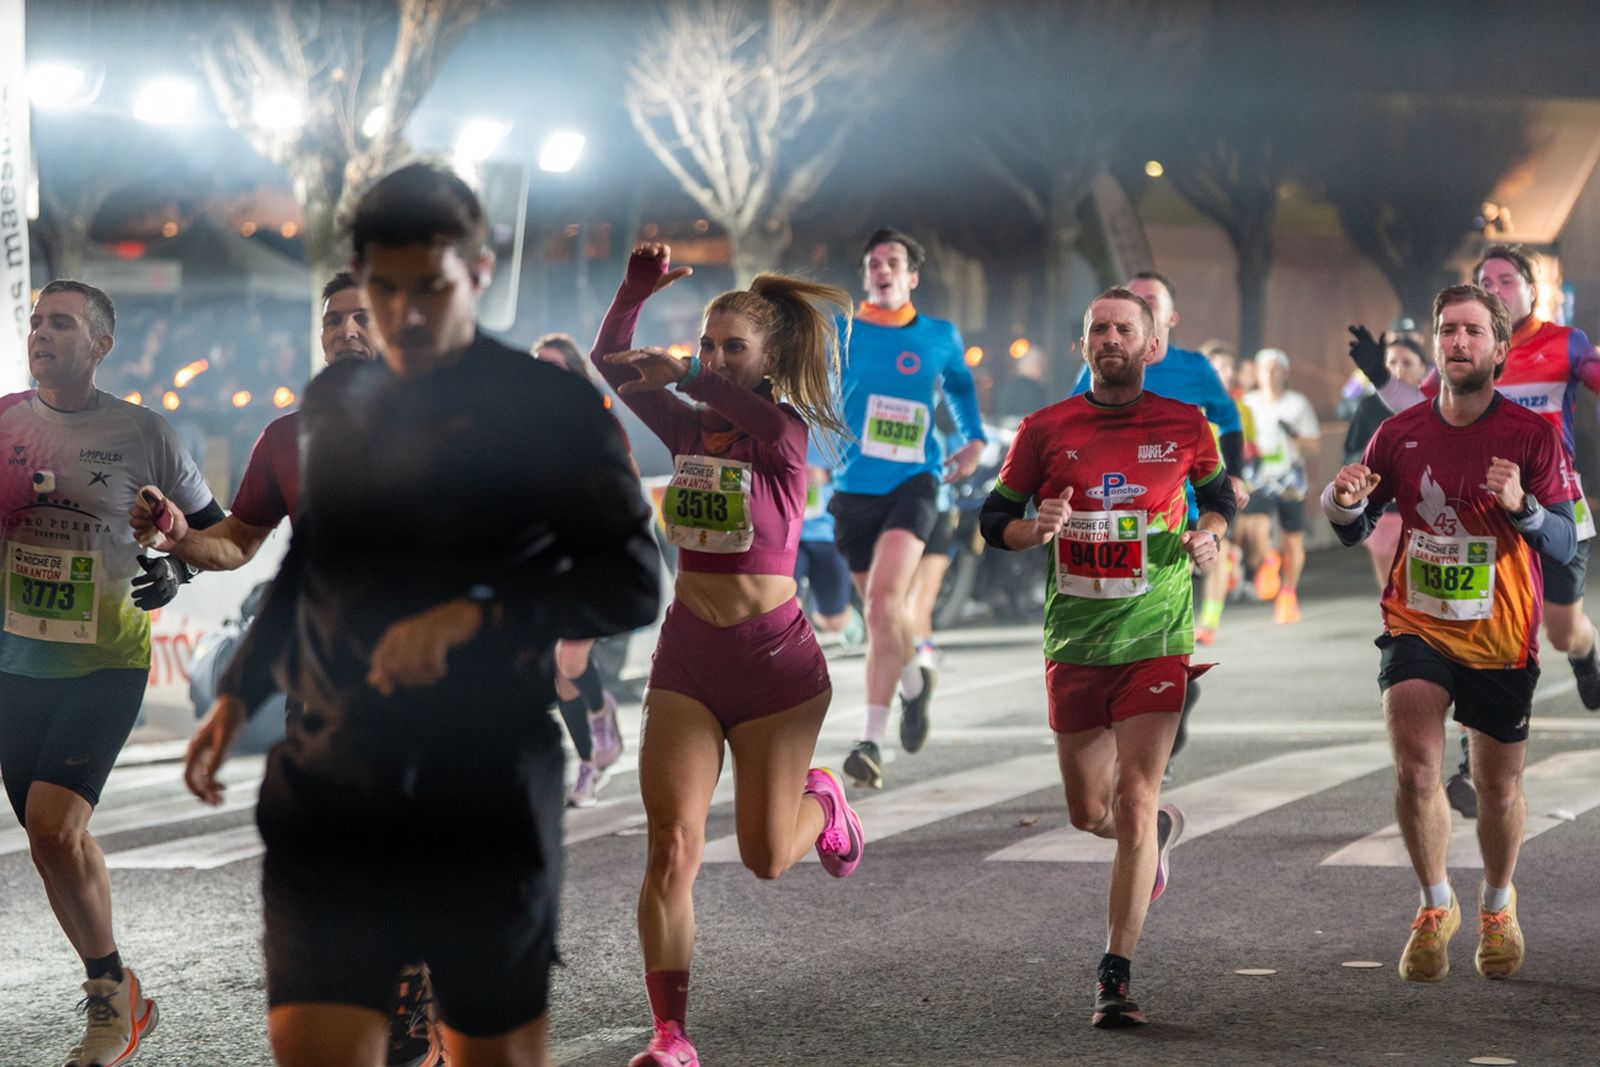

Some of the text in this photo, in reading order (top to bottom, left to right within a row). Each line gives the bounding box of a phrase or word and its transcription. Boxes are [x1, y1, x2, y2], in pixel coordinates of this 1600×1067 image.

[877, 420, 919, 441] 13313
[677, 489, 728, 522] 3513
[49, 520, 111, 533] PUERTA
[1063, 529, 1079, 539] SAN
[1070, 521, 1110, 530] NOCHE DE
[1434, 513, 1457, 536] 43
[23, 556, 63, 569] NOCHE DE
[1071, 541, 1128, 569] 9402
[15, 563, 30, 576] SAN
[1422, 564, 1475, 592] 1382
[23, 578, 75, 610] 3773
